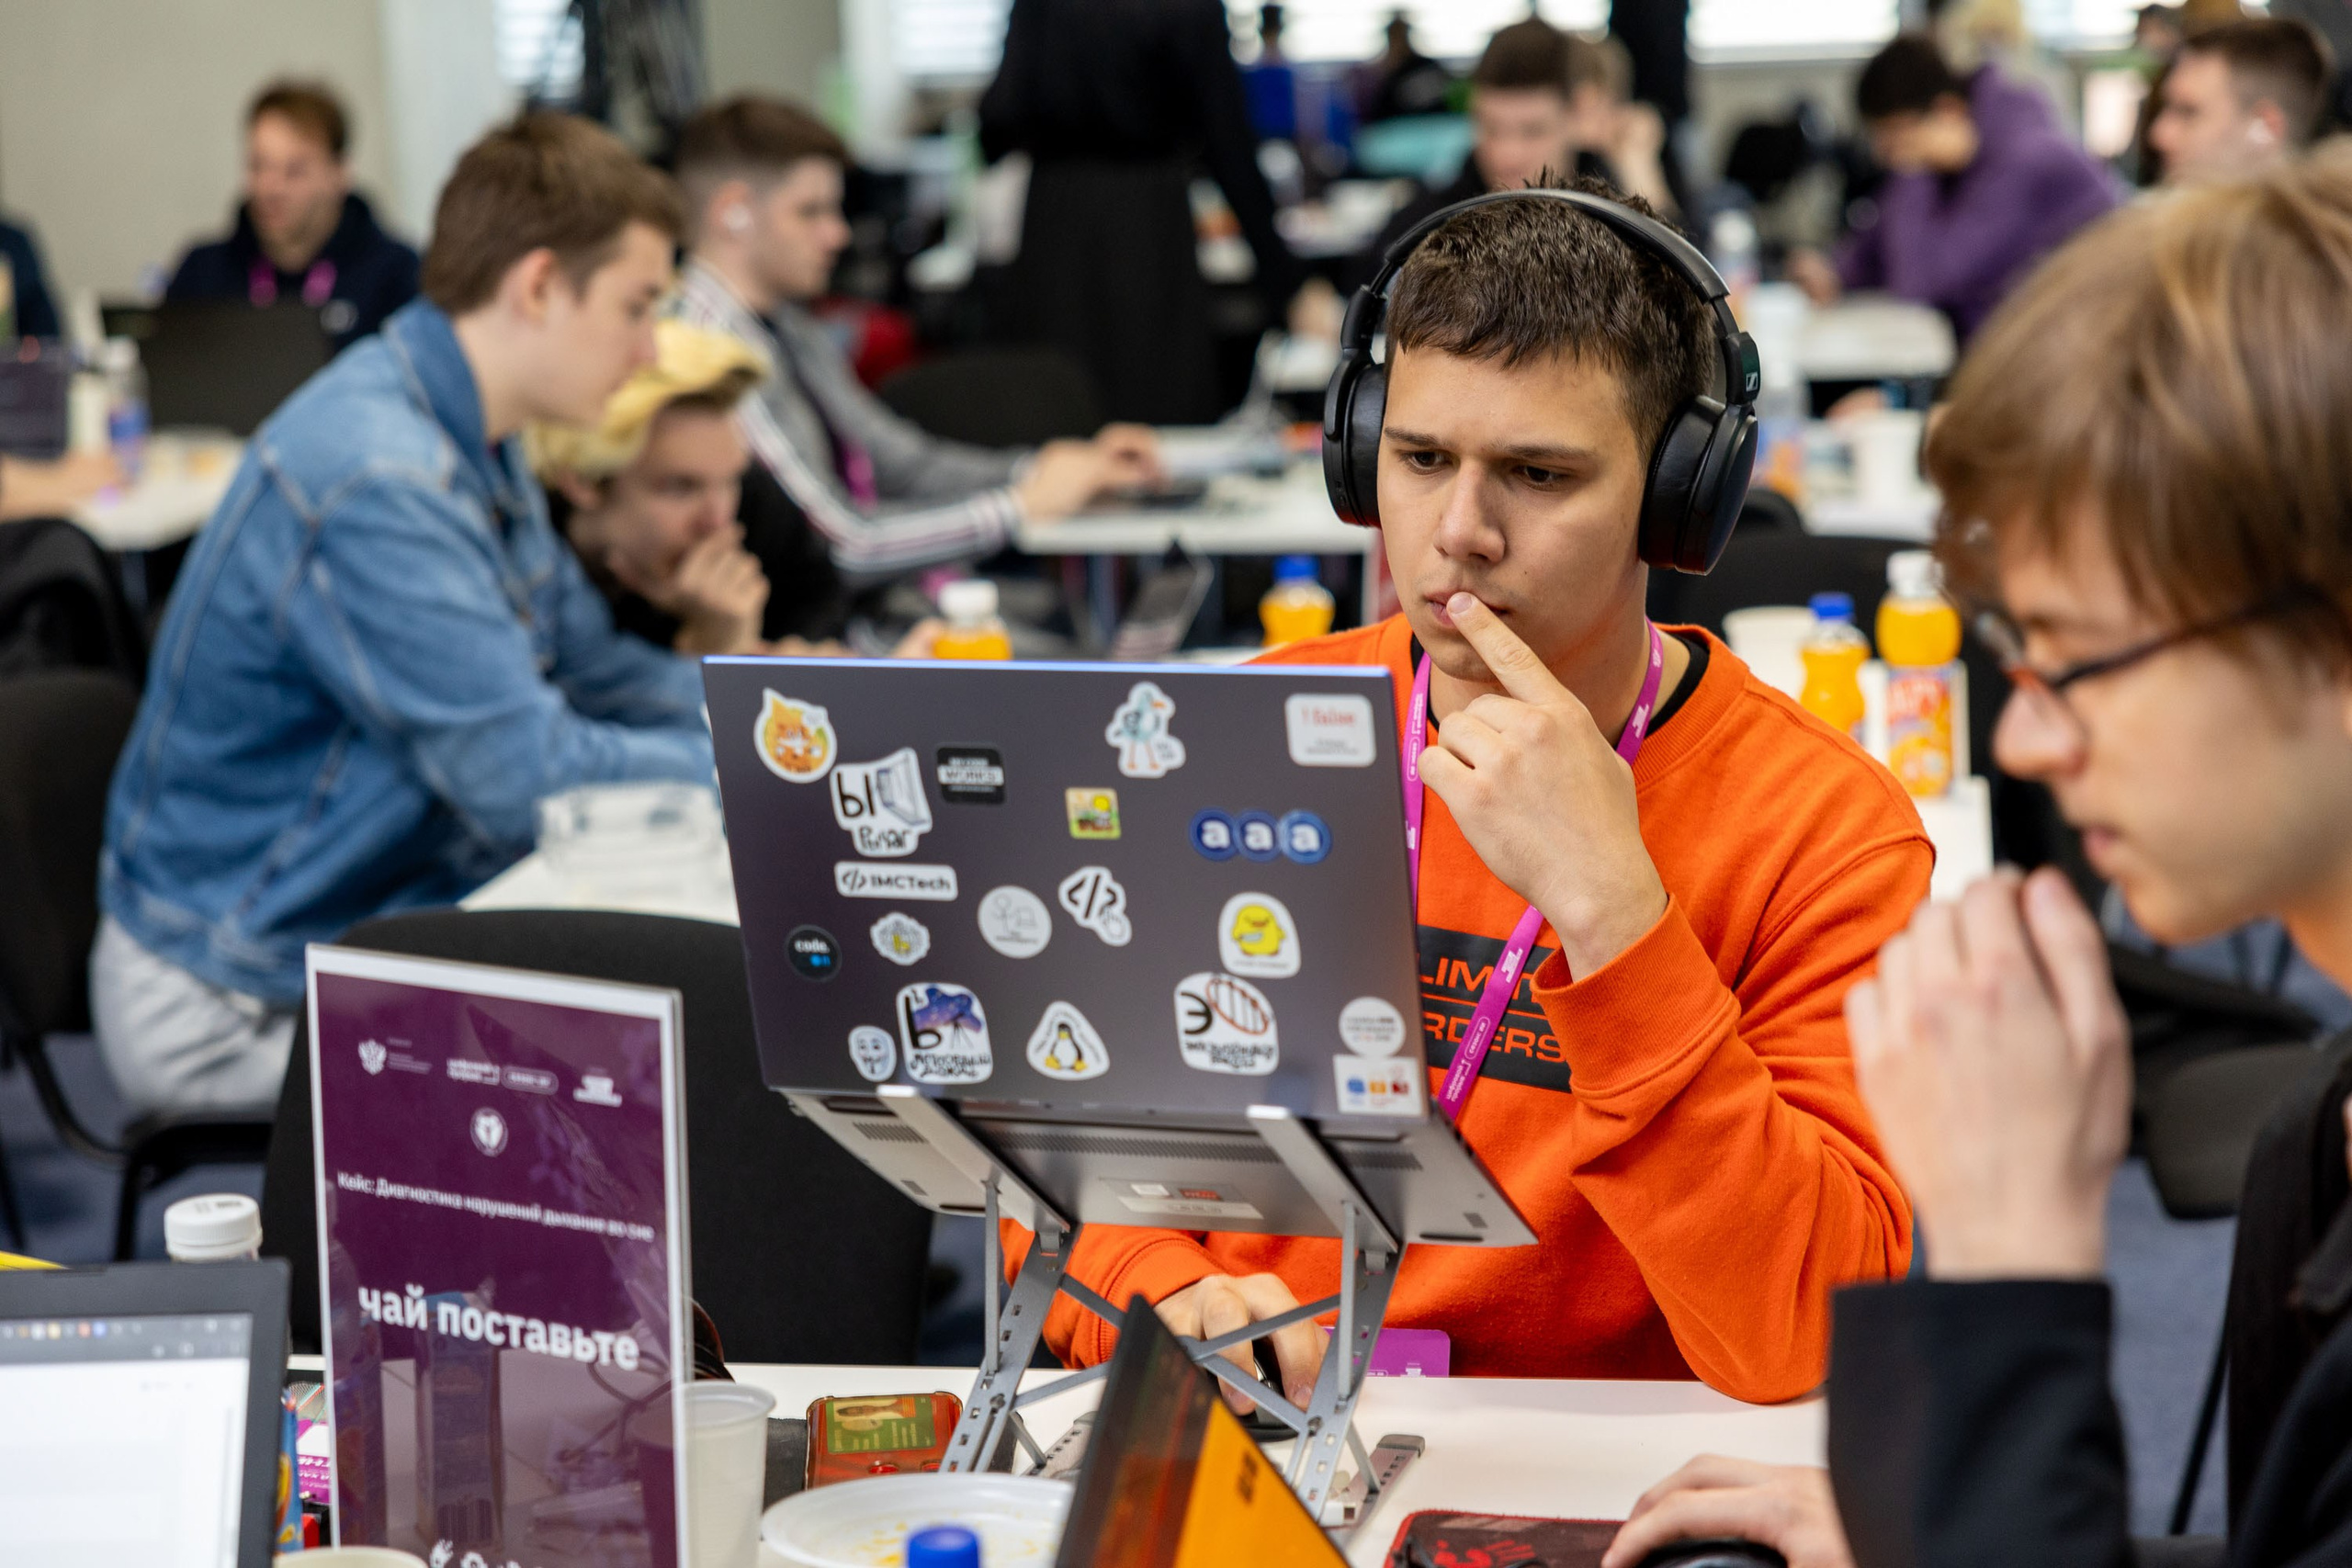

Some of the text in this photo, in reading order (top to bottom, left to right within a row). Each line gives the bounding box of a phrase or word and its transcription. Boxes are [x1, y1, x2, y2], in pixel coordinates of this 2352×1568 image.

[337, 1169, 375, 1195] Кейс:
[376, 1177, 462, 1210] Диагностика
[358, 1282, 640, 1371] чай поставьте
